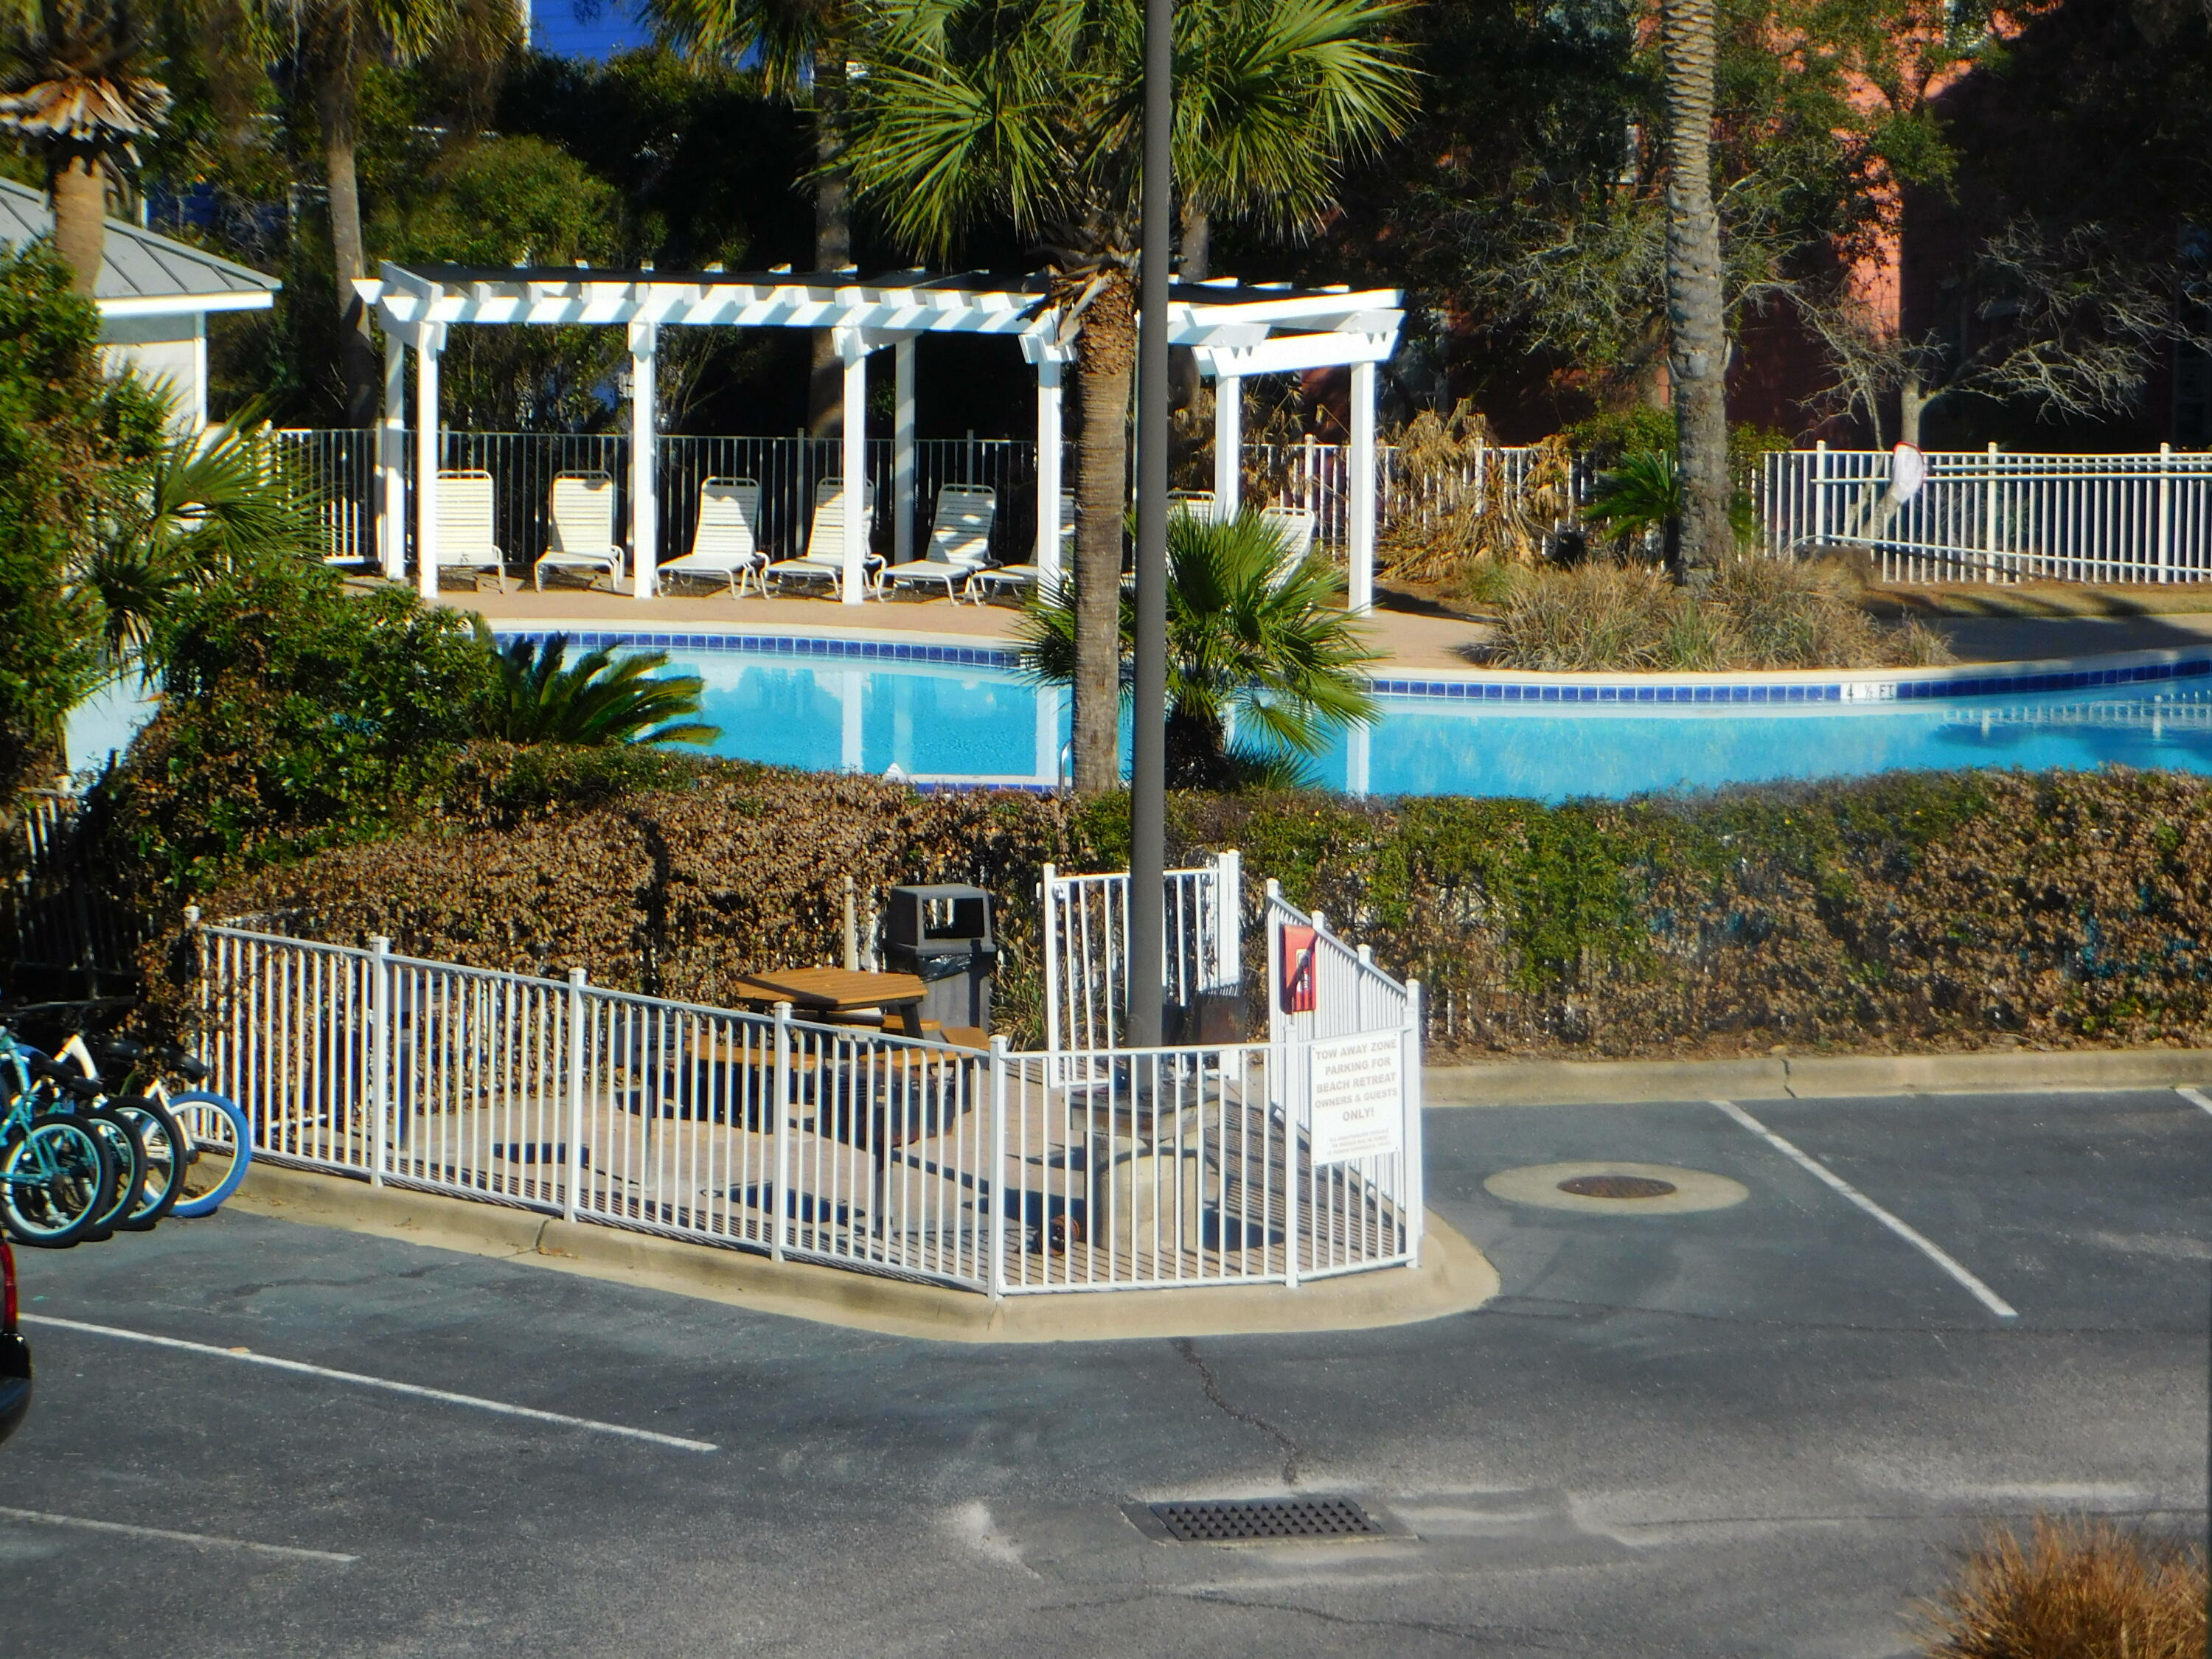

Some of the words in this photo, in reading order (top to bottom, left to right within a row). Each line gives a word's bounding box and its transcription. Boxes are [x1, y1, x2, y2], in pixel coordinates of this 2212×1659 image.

[1315, 1048, 1338, 1060] TOW
[1340, 1043, 1368, 1057] AWAY
[1371, 1039, 1397, 1051] ZONE
[1325, 1060, 1368, 1076] PARKING
[1371, 1057, 1391, 1068] FOR
[1316, 1079, 1350, 1093] BEACH
[1353, 1072, 1397, 1088] RETREAT
[1315, 1095, 1352, 1108] OWNERS
[1354, 1094, 1361, 1102] &
[1363, 1088, 1398, 1101] GUESTS
[1343, 1107, 1374, 1121] ONLY!
